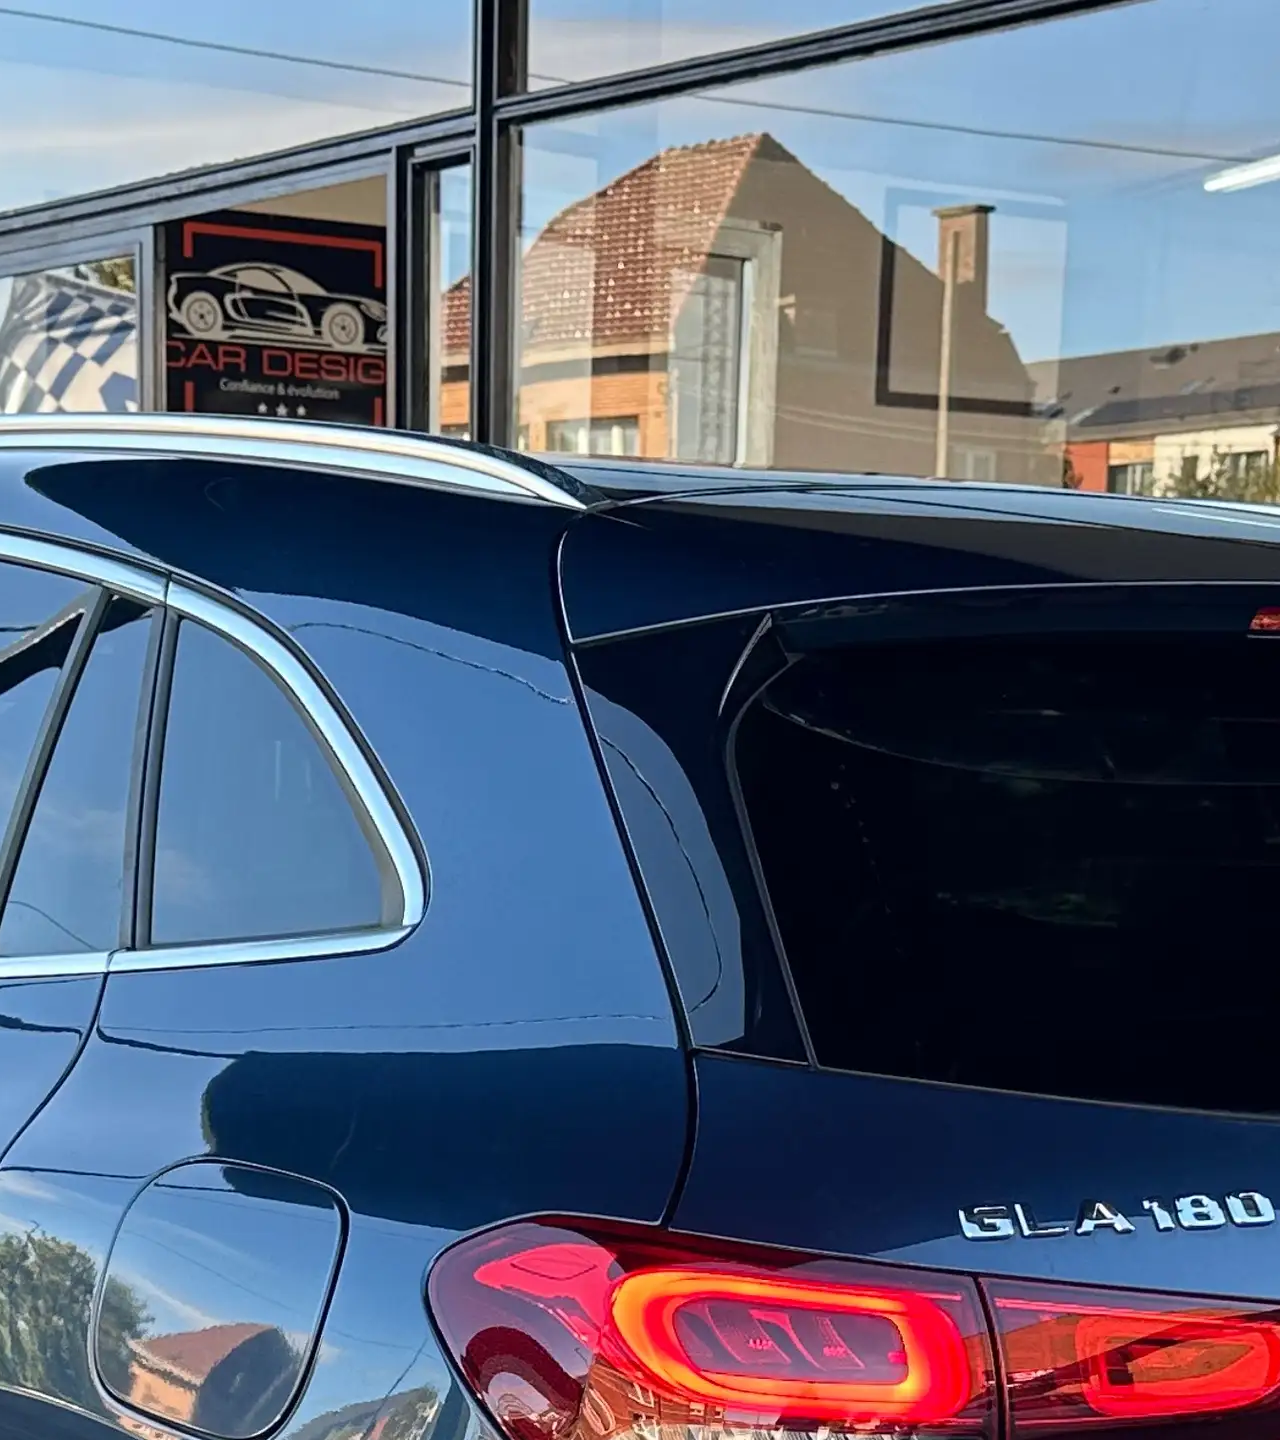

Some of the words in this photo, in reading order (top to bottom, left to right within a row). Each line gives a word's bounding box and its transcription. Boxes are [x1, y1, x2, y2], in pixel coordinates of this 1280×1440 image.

[167, 341, 247, 373] CAR
[262, 350, 385, 385] DESIG
[958, 1200, 1136, 1240] GLA
[1141, 1190, 1277, 1232] 180
